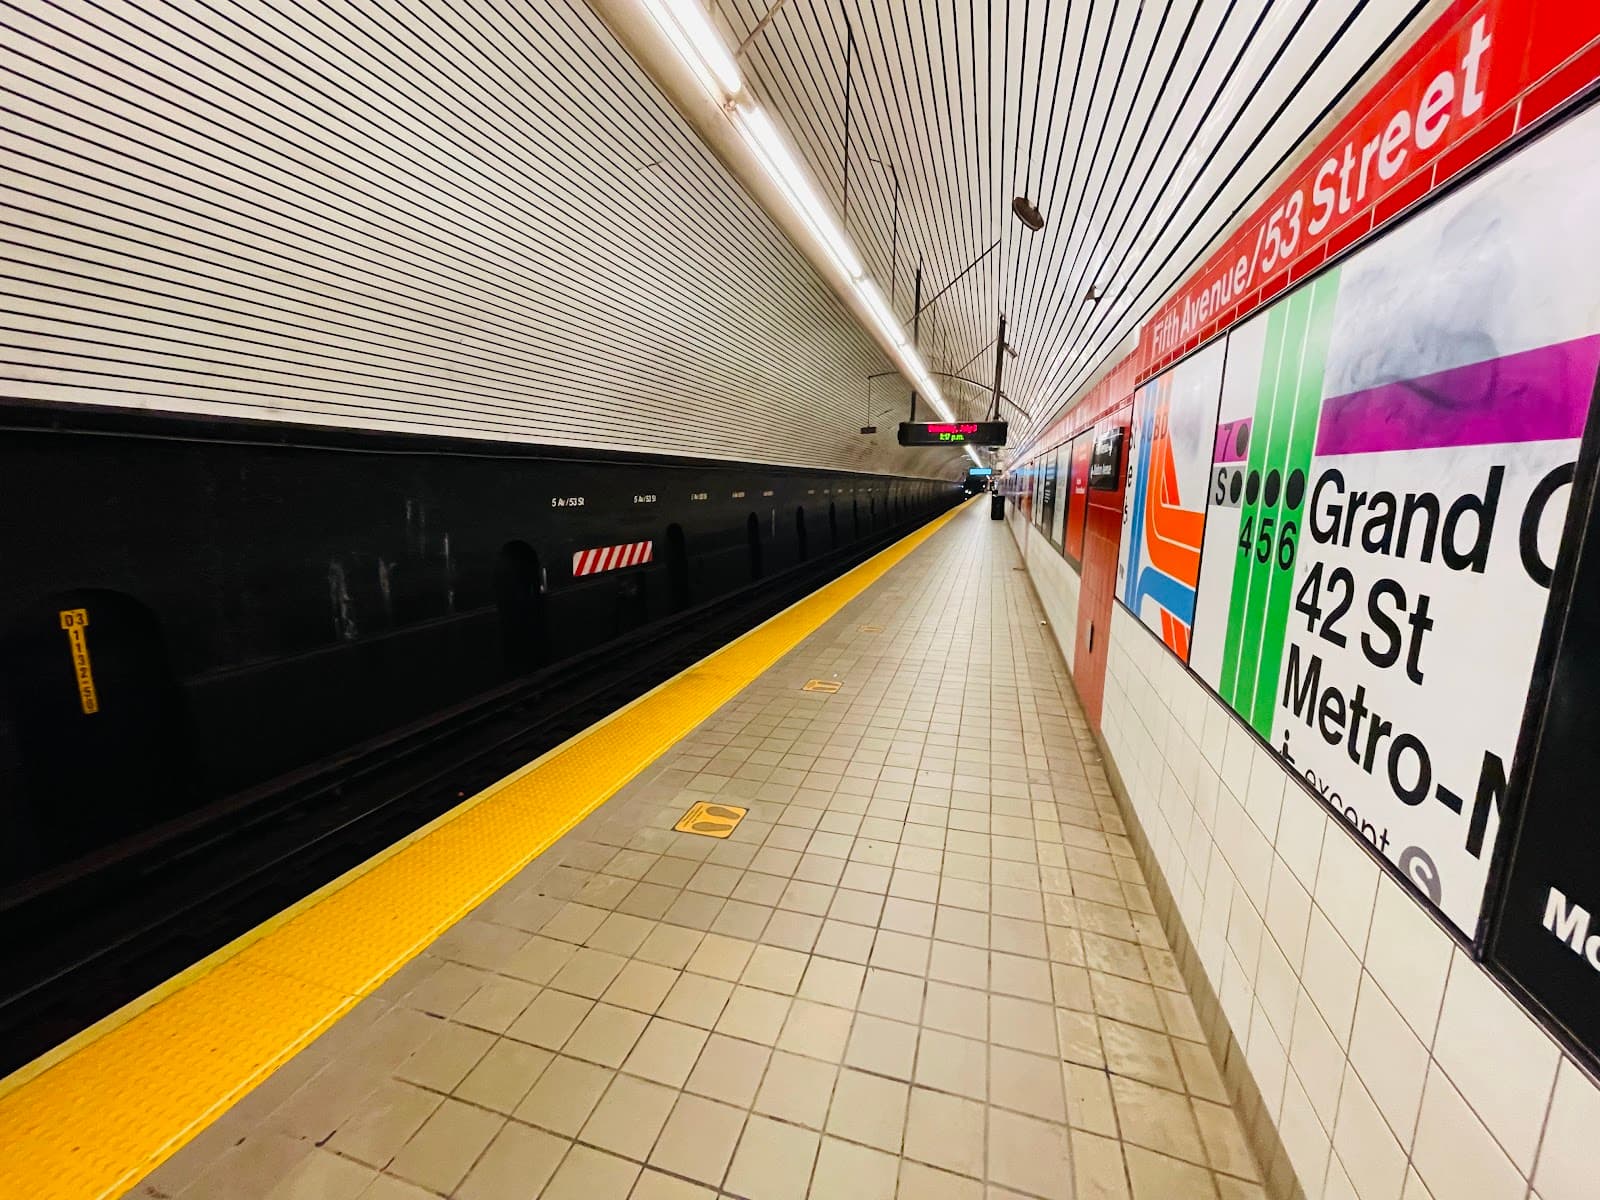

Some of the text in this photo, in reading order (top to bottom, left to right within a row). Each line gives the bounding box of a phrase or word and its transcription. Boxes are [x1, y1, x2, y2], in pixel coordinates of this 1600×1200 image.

[1152, 309, 1180, 359] Fifth
[1308, 14, 1493, 236] Street
[1223, 423, 1233, 462] 7
[1216, 467, 1227, 505] S
[1309, 465, 1505, 573] Grand
[1239, 516, 1297, 571] 4 5 6
[1295, 562, 1434, 686] 42 St
